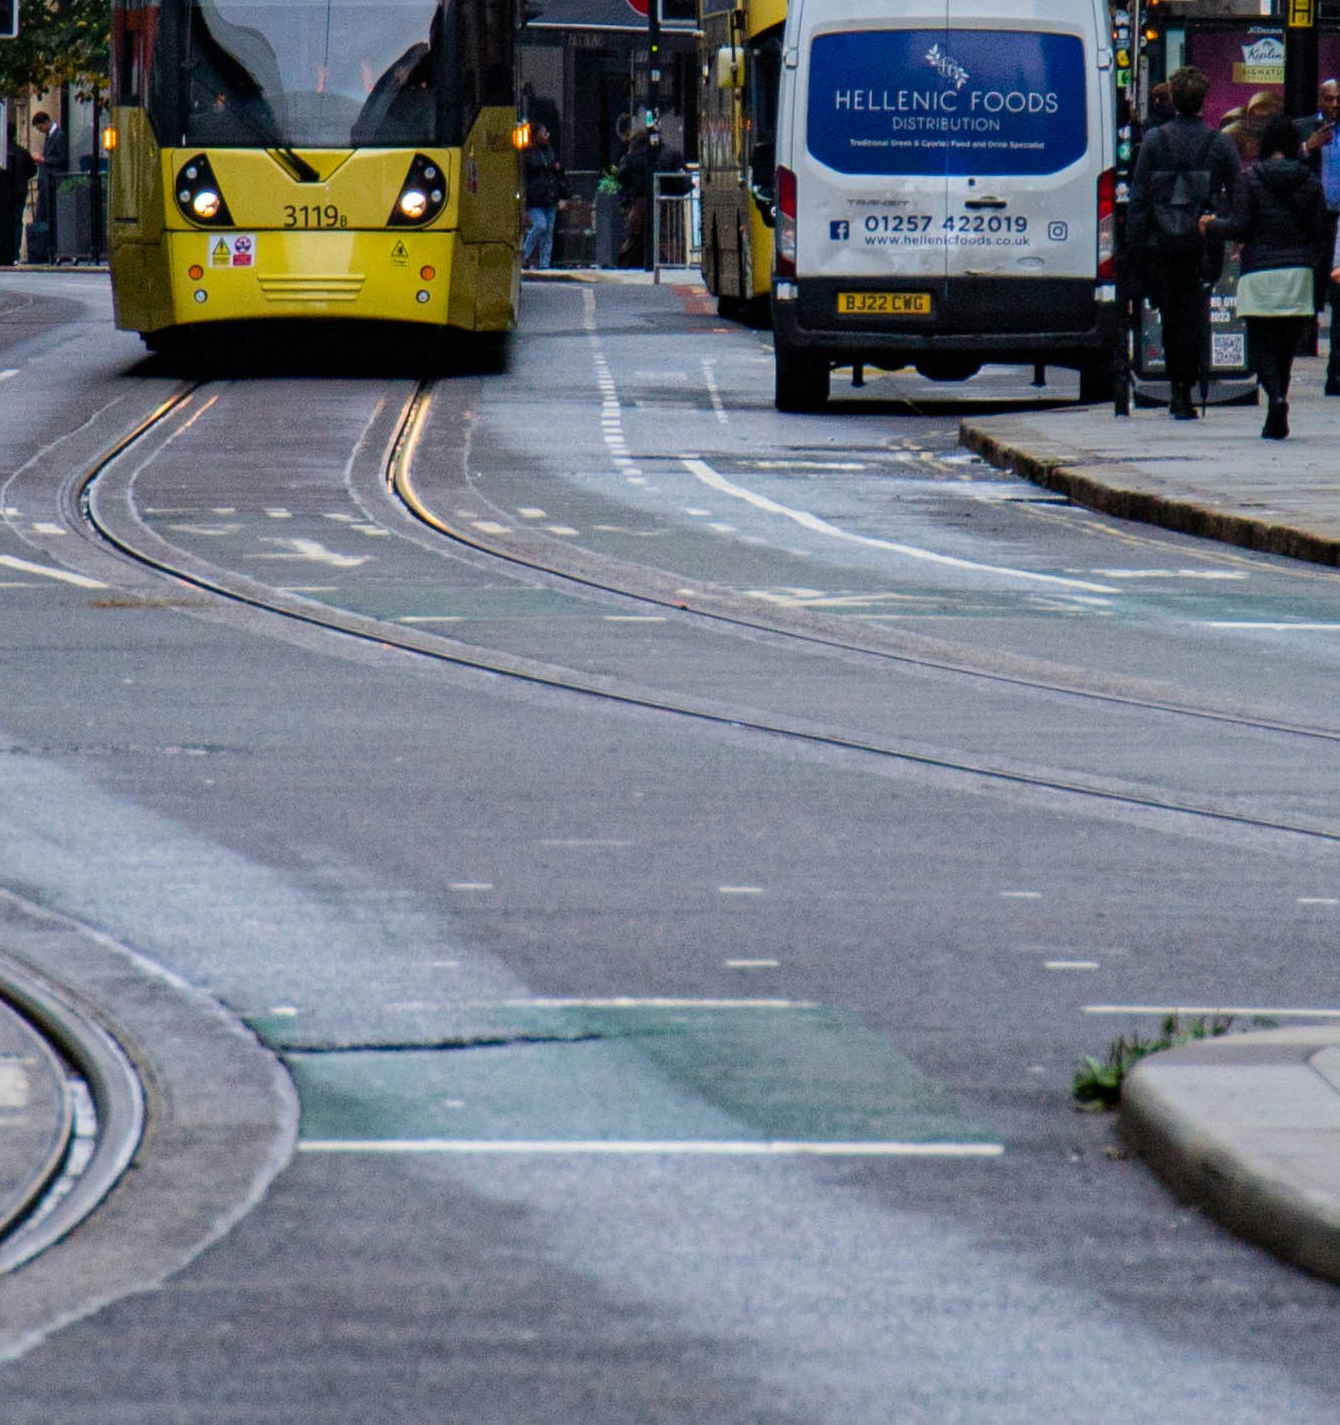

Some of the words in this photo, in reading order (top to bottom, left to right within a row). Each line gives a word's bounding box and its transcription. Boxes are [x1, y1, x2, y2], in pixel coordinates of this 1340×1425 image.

[1248, 48, 1284, 62] Kiplin
[835, 89, 958, 112] HELLENIC
[970, 90, 1059, 114] FOODS
[892, 116, 1001, 132] DISTRIBUTION
[849, 138, 889, 147] Traditional
[950, 139, 971, 148] Food
[972, 140, 987, 148] and
[864, 215, 933, 232] 01257
[941, 215, 1028, 233] 422019
[865, 234, 1030, 247] www.hellenicfoods.co.uk
[846, 294, 888, 310] BJ22
[891, 294, 924, 310] CWG
